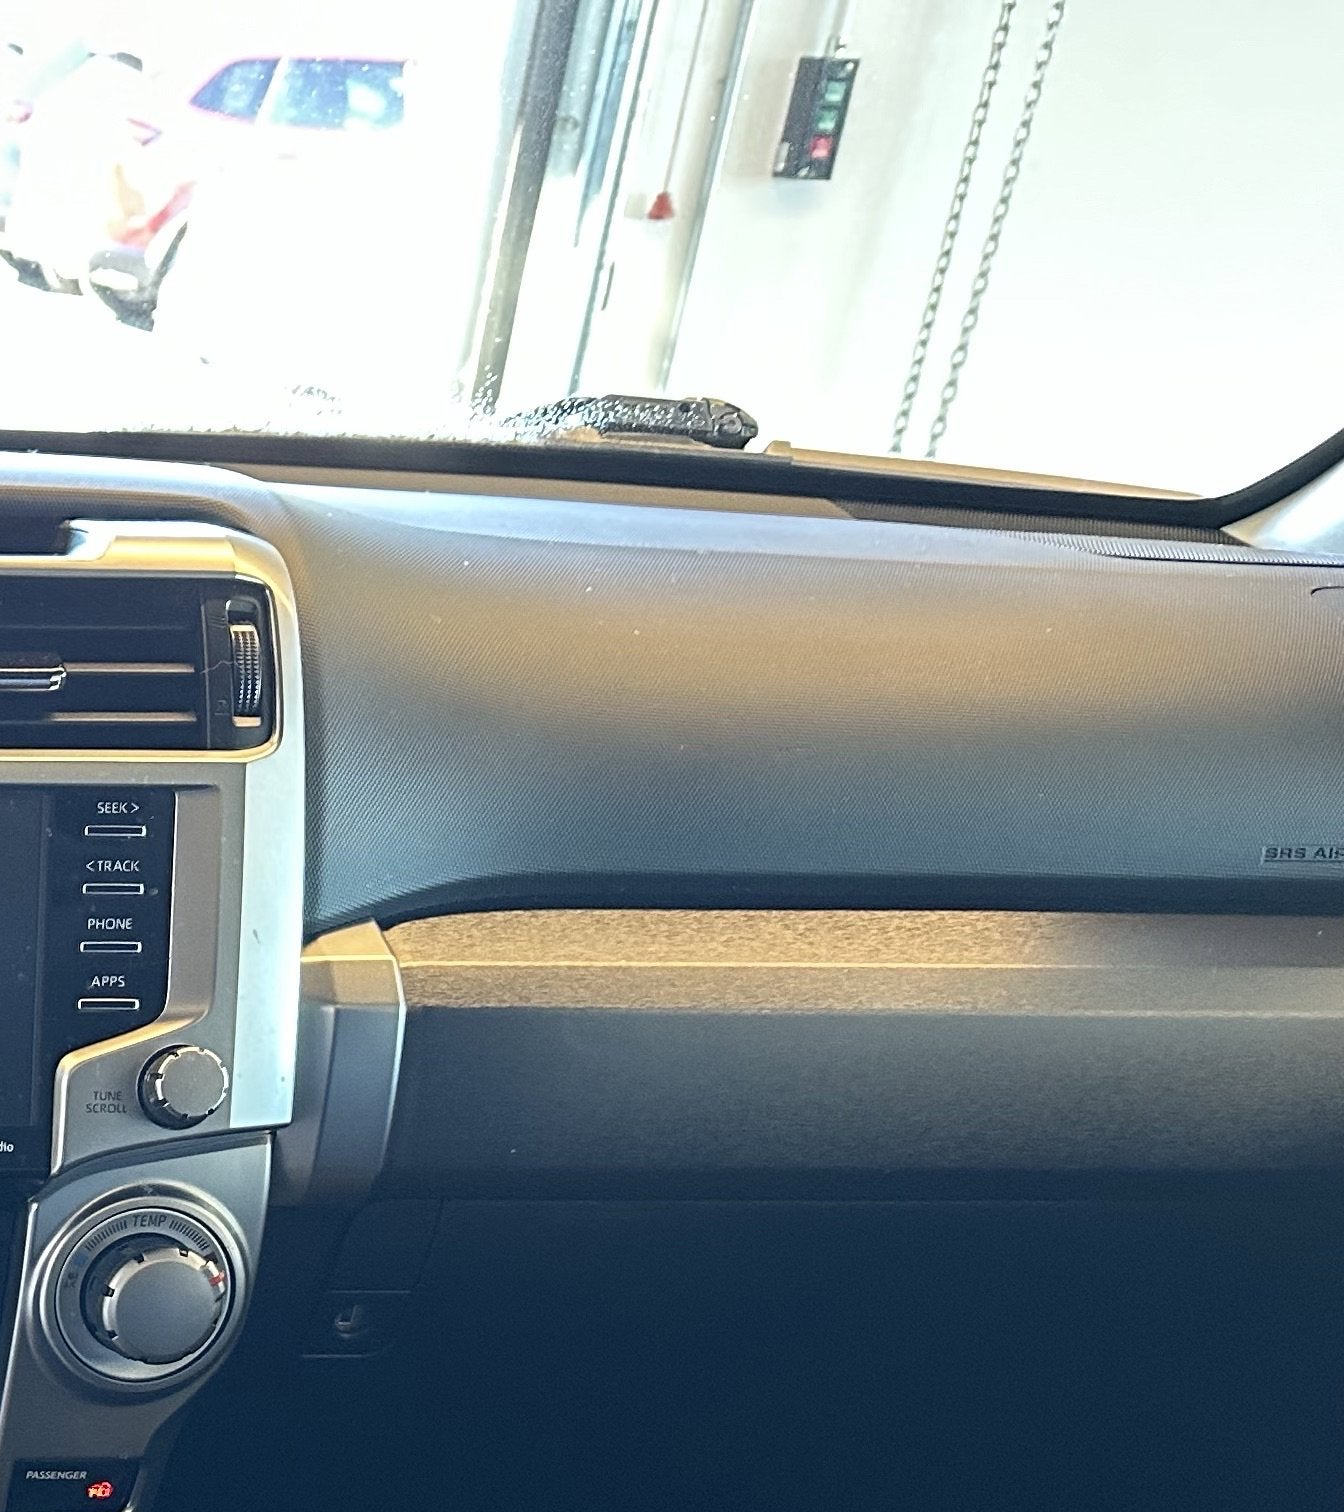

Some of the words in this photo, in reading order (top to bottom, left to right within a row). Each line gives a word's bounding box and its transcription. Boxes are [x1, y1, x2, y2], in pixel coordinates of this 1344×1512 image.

[97, 802, 128, 814] SEEK
[97, 860, 140, 872] TRACK
[87, 918, 133, 930] PHONE
[91, 976, 126, 988] APPS
[93, 1090, 123, 1101] TUNE
[86, 1103, 128, 1114] SCROLL
[133, 1214, 168, 1228] TEMP
[25, 1470, 87, 1480] PASSENGER
